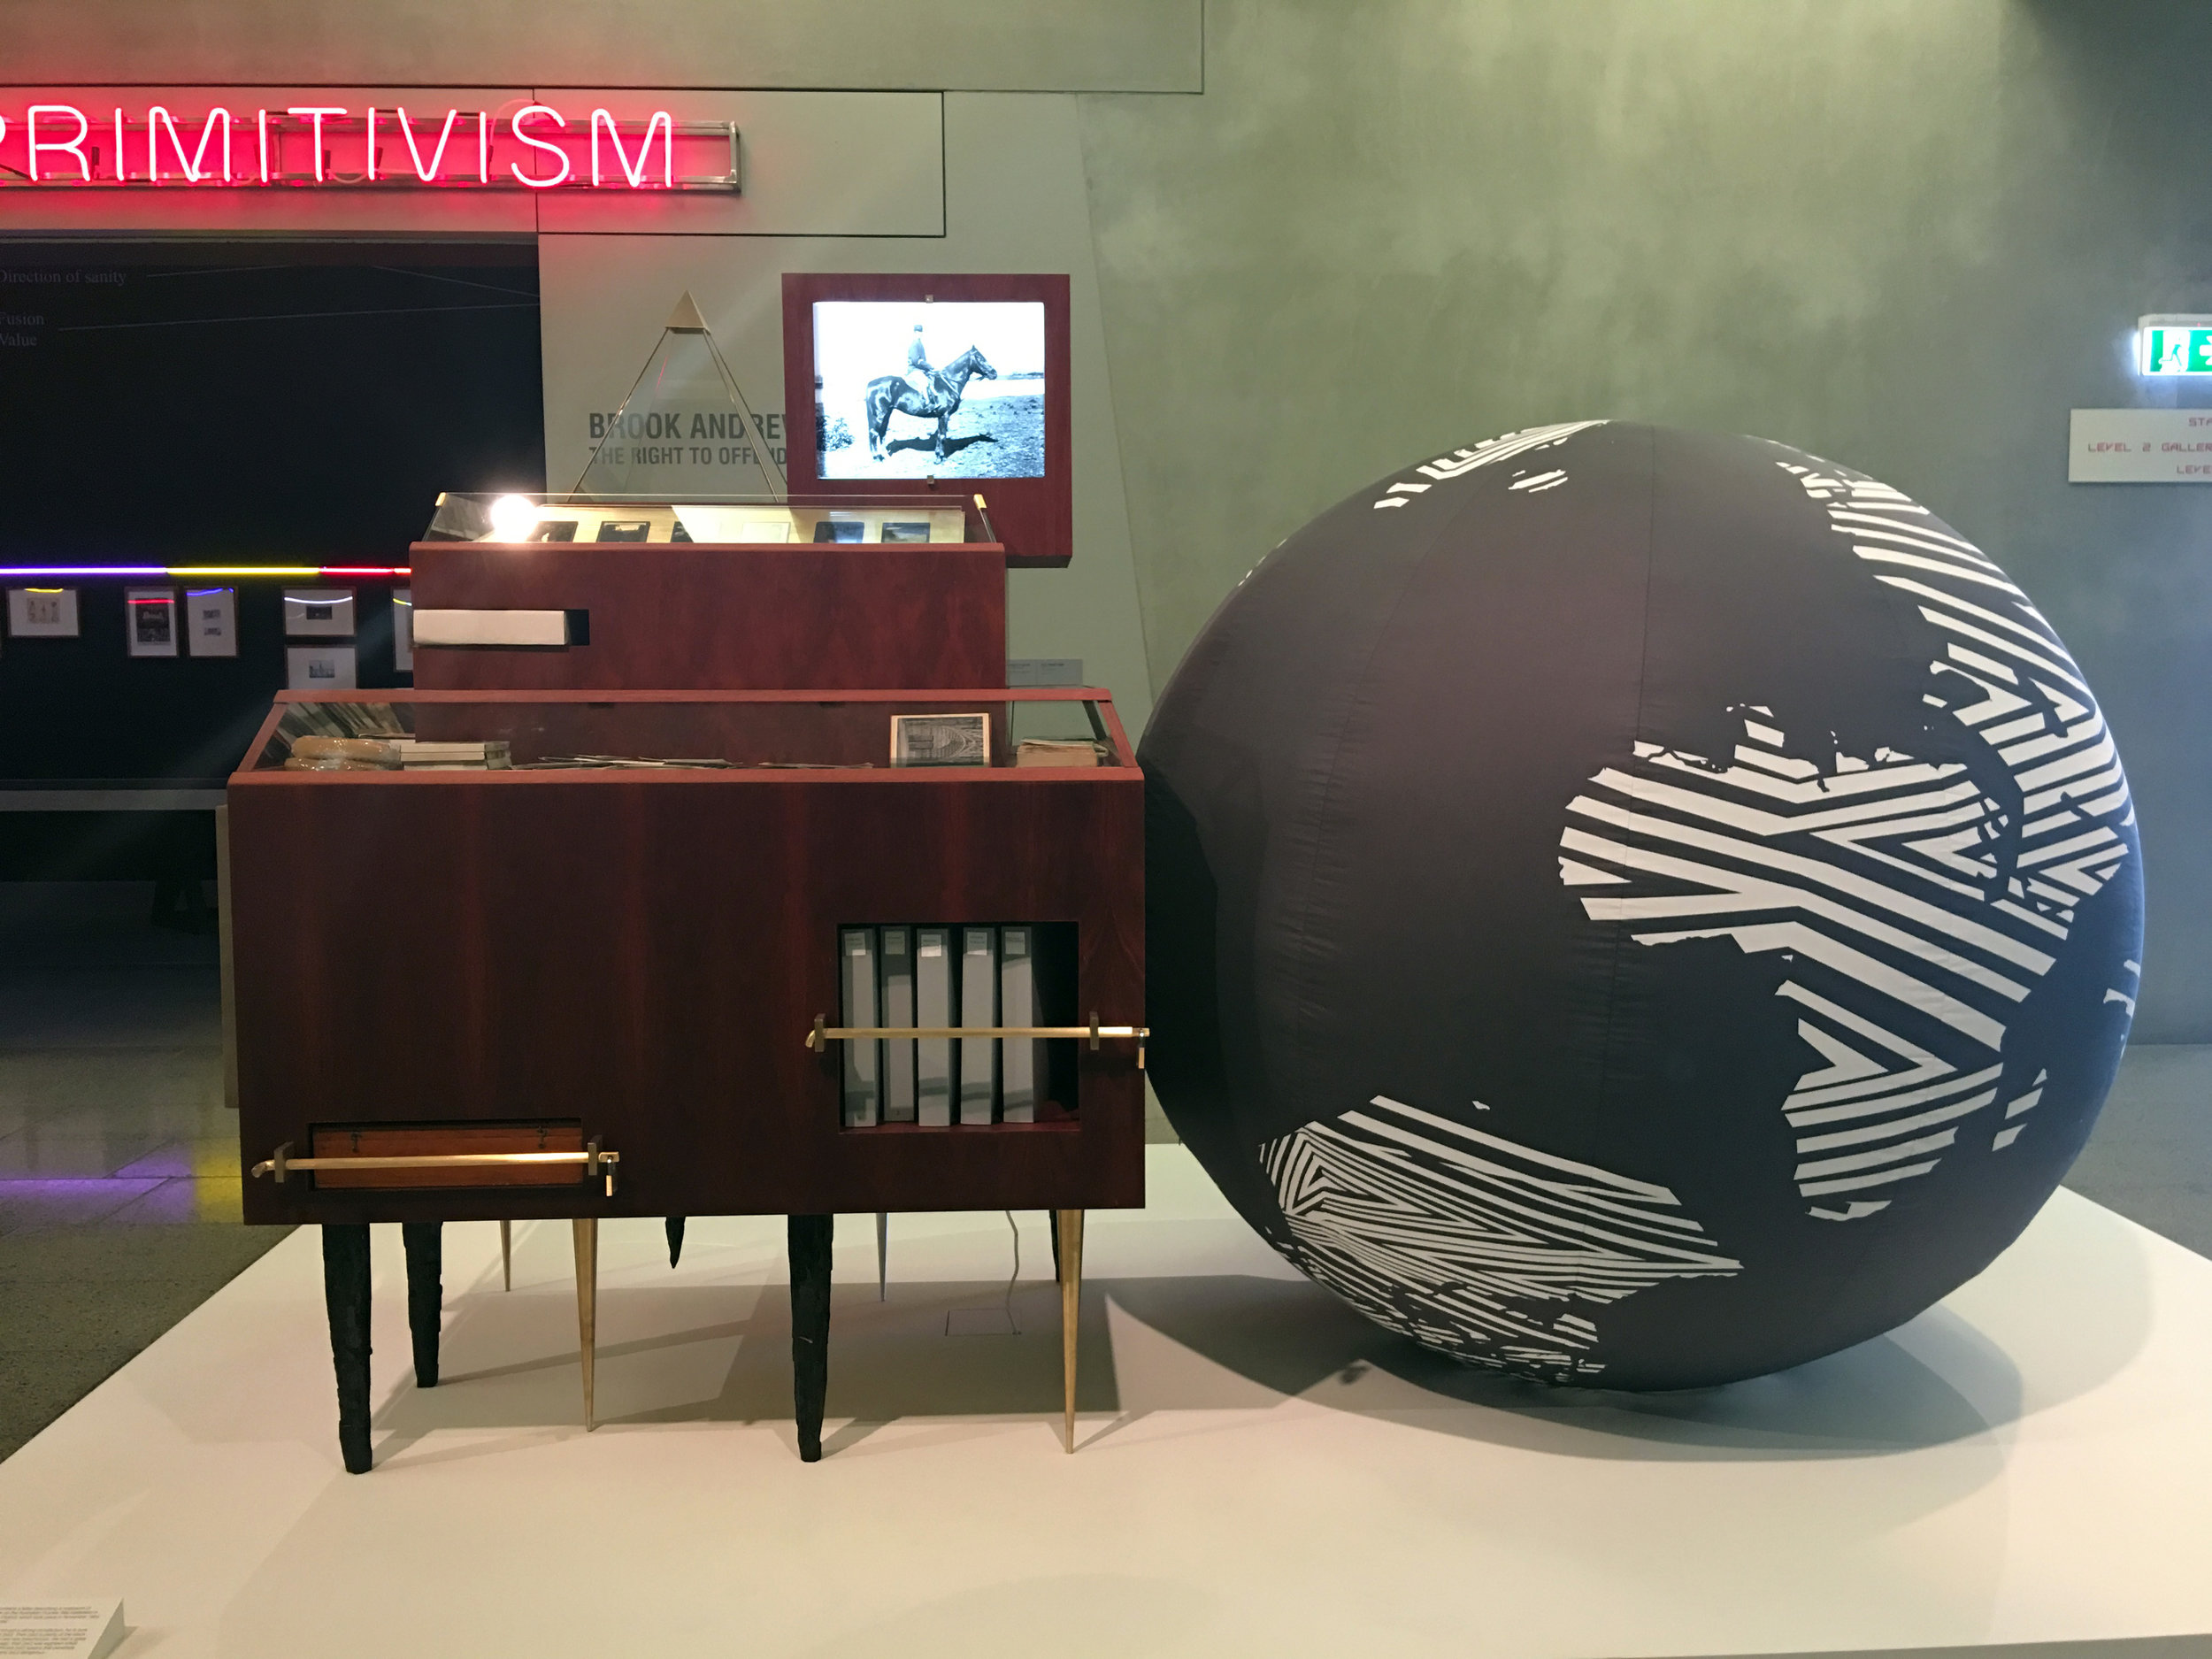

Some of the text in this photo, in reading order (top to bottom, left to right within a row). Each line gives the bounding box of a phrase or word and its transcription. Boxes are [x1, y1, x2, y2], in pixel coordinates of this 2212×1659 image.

[0, 105, 673, 188] RIMITIVISM
[0, 268, 127, 287] Direction of sanity
[0, 334, 38, 347] Value
[589, 412, 682, 440] BROOK
[589, 447, 625, 465] THE
[631, 447, 683, 465] RIGHT
[689, 447, 712, 465] TO
[2088, 442, 2131, 452] LEVEL
[2142, 442, 2152, 452] 2
